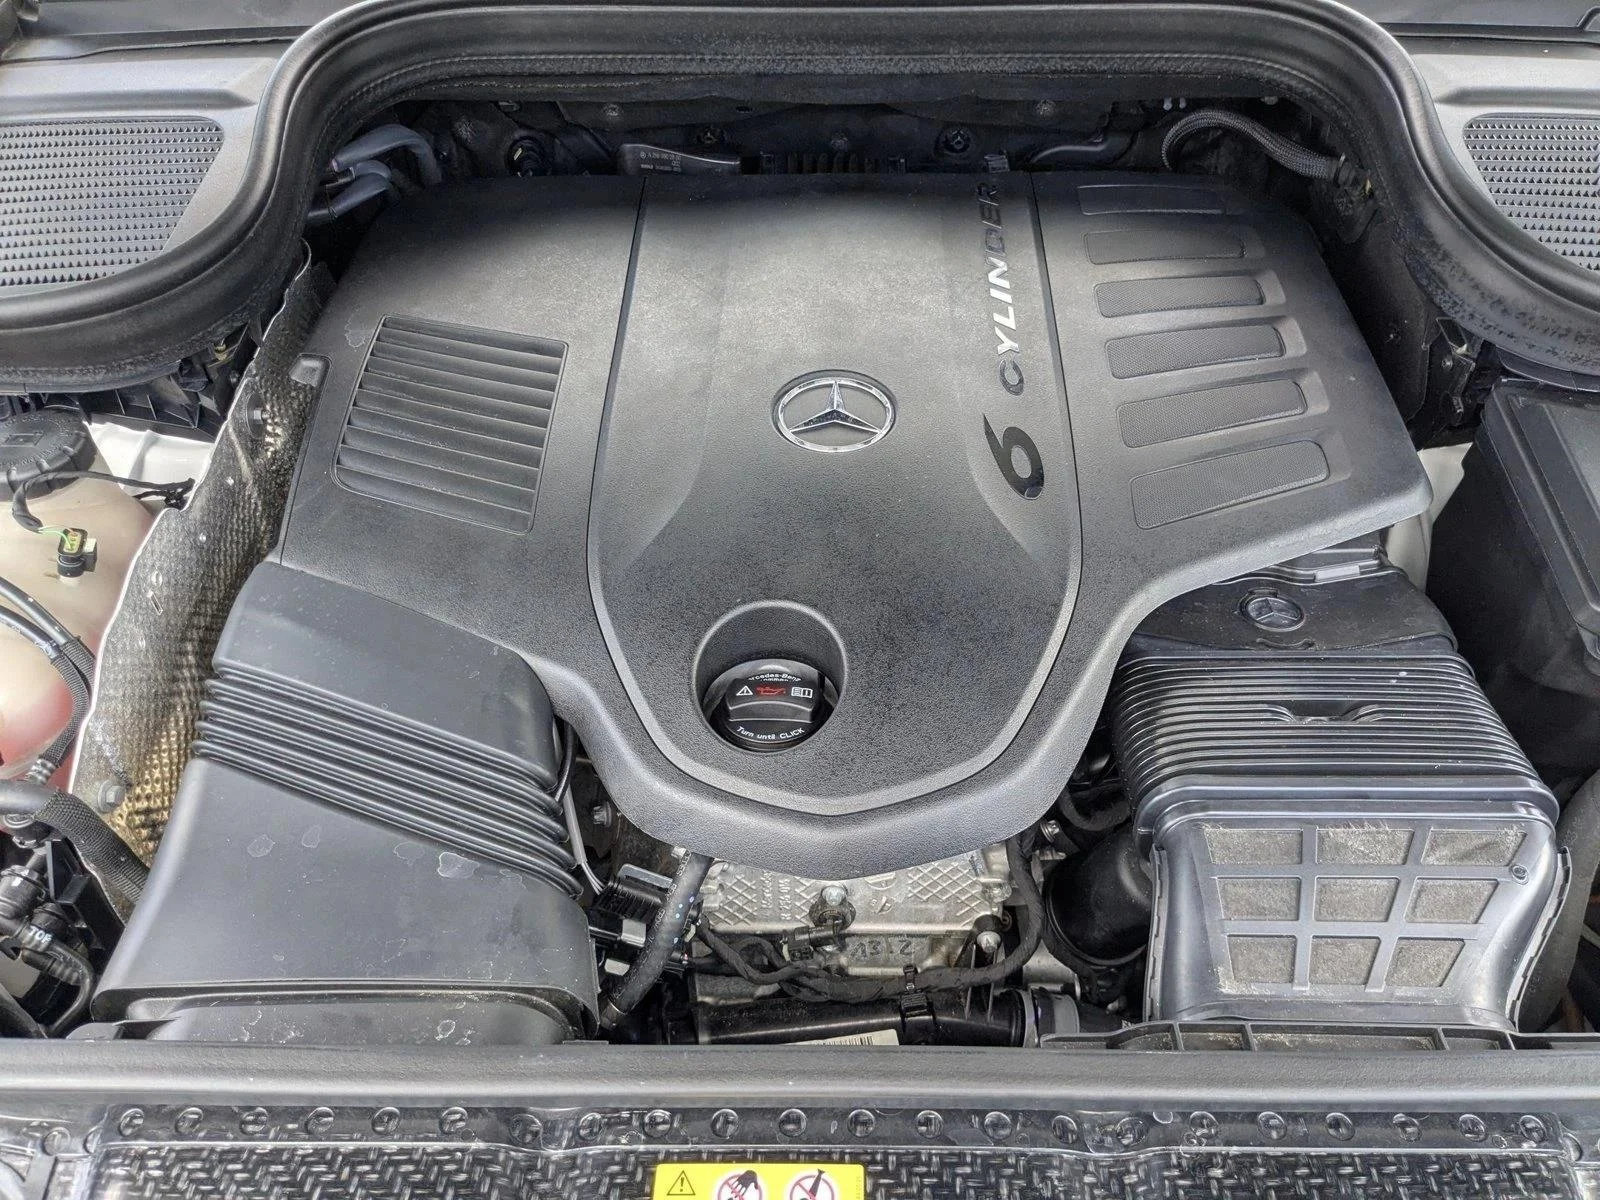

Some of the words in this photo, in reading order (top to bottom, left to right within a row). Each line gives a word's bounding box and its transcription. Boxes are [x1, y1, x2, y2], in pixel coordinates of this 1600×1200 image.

[977, 181, 1025, 396] CYLINDER
[982, 413, 1045, 500] 6
[736, 726, 754, 738] Turn
[779, 727, 805, 740] CLICK
